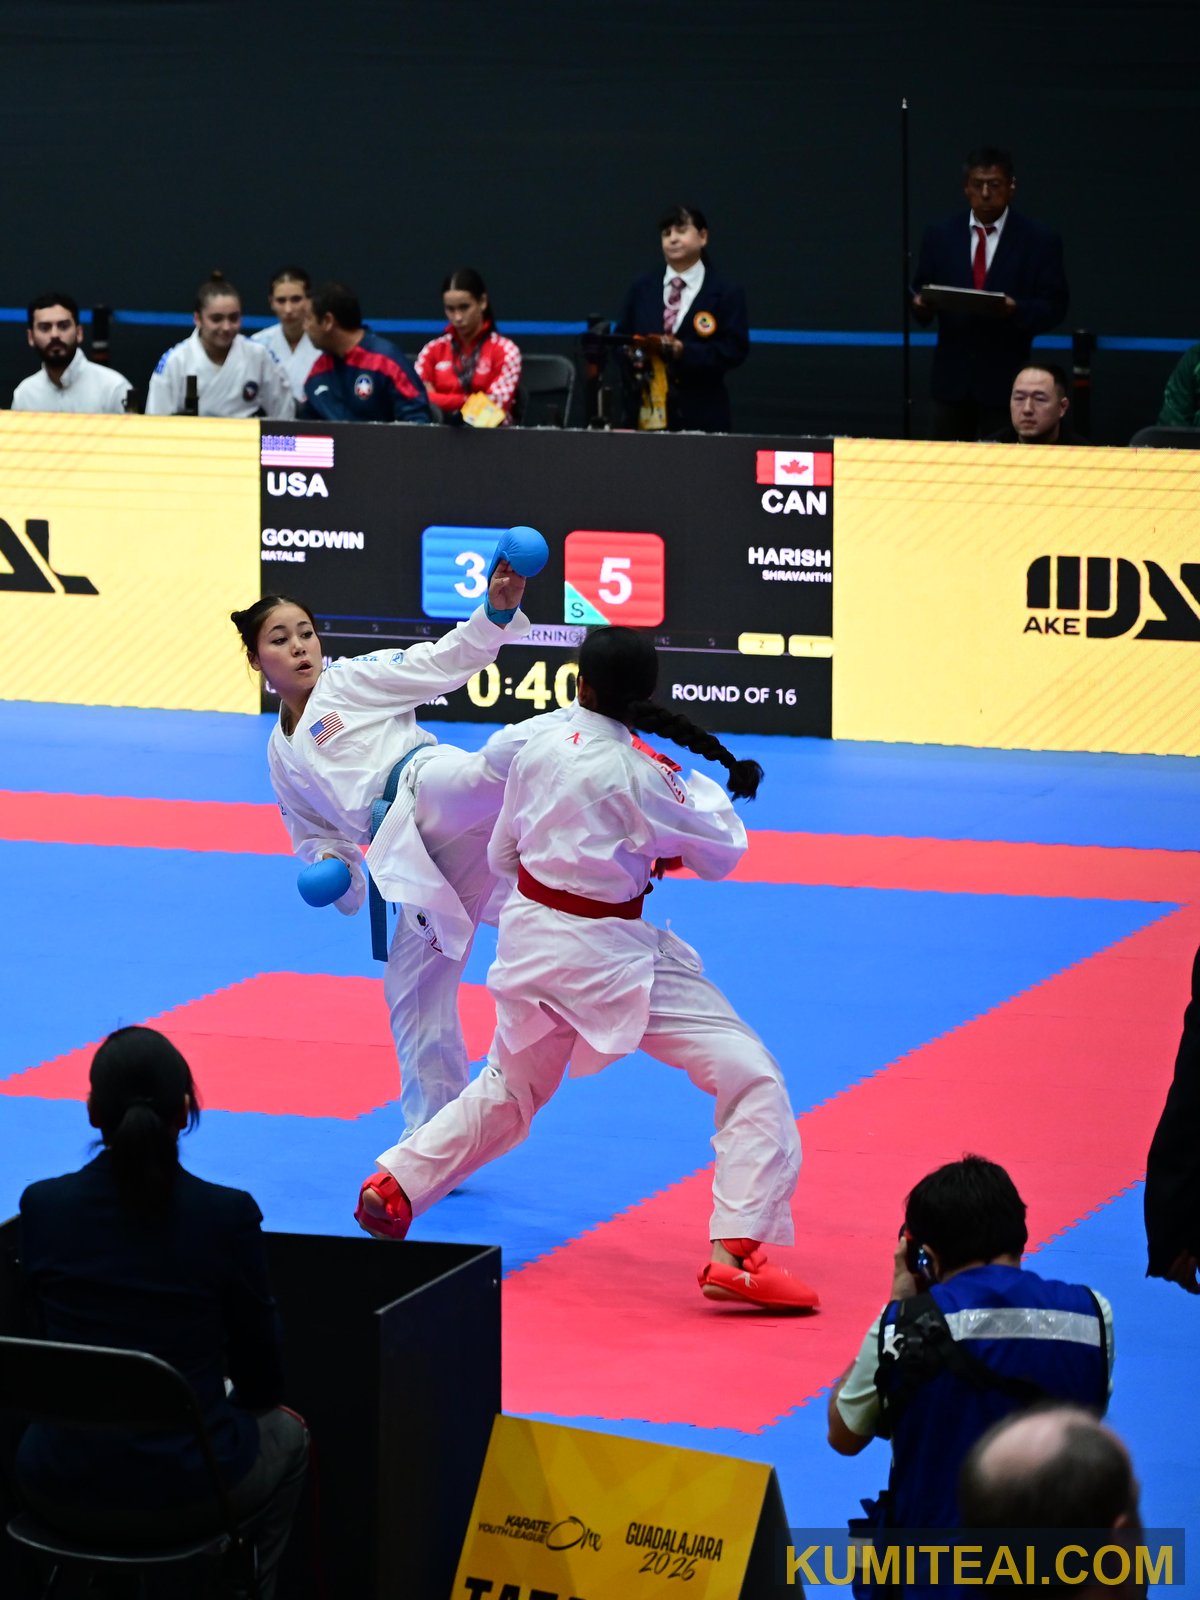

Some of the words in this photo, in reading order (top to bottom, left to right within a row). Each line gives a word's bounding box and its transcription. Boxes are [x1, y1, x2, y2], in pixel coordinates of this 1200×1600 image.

[267, 472, 329, 498] USA
[761, 488, 827, 516] CAN
[261, 528, 365, 550] GOODWIN
[261, 550, 306, 563] NATALIE
[748, 546, 831, 568] HARISH
[454, 551, 488, 599] 3
[598, 556, 633, 605] 5
[762, 570, 832, 583] SHRAVANTHI
[570, 602, 585, 619] S
[1023, 616, 1081, 635] AKE
[467, 661, 579, 709] 0:40
[671, 683, 740, 703] ROUND
[744, 687, 770, 704] OF
[775, 688, 797, 705] 16
[478, 1521, 509, 1537] YOUTH
[507, 1528, 547, 1545] LEAGUE
[505, 1514, 552, 1534] KARATE
[625, 1522, 724, 1562] GUADALAJARA
[638, 1551, 699, 1581] 2026
